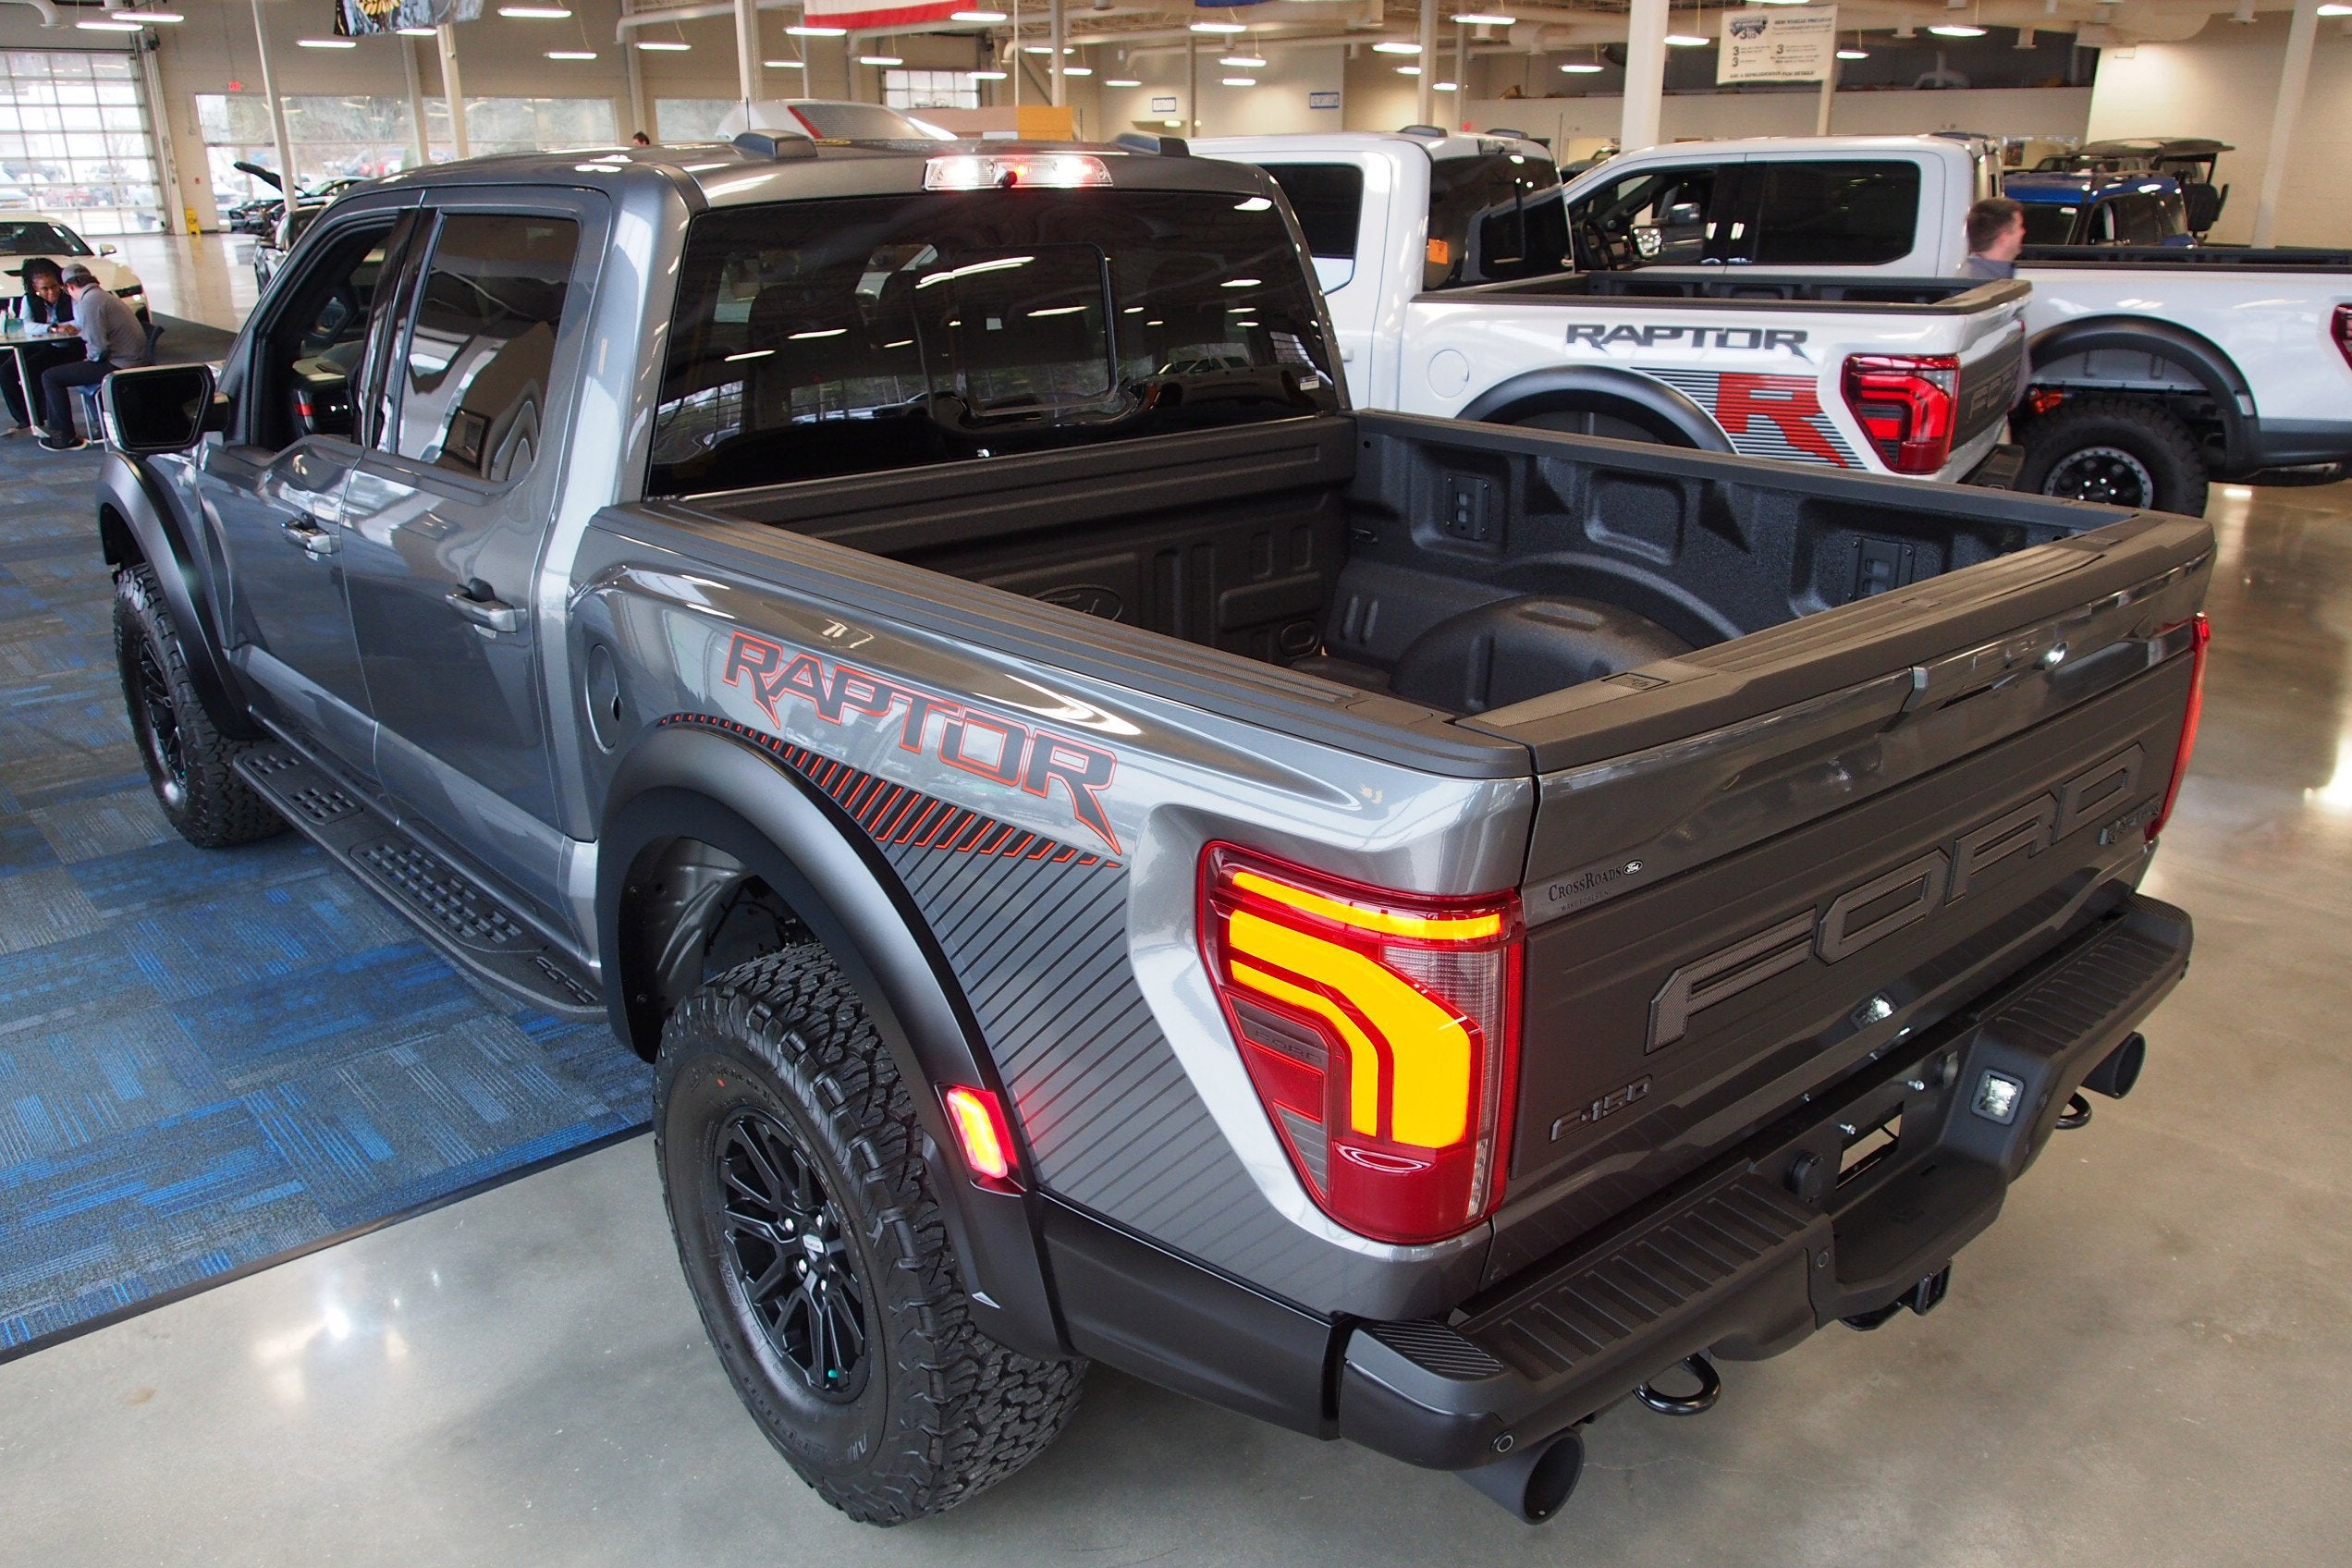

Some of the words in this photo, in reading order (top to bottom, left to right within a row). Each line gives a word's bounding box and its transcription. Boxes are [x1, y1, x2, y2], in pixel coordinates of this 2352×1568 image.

[1732, 56, 1739, 67] 3
[1733, 45, 1740, 56] 3
[1776, 43, 1784, 55] 3
[1566, 324, 1815, 364] RAPTOR
[723, 631, 1122, 855] RAPTOR
[1645, 742, 2146, 1056] FORD
[1255, 1029, 1323, 1065] FORD
